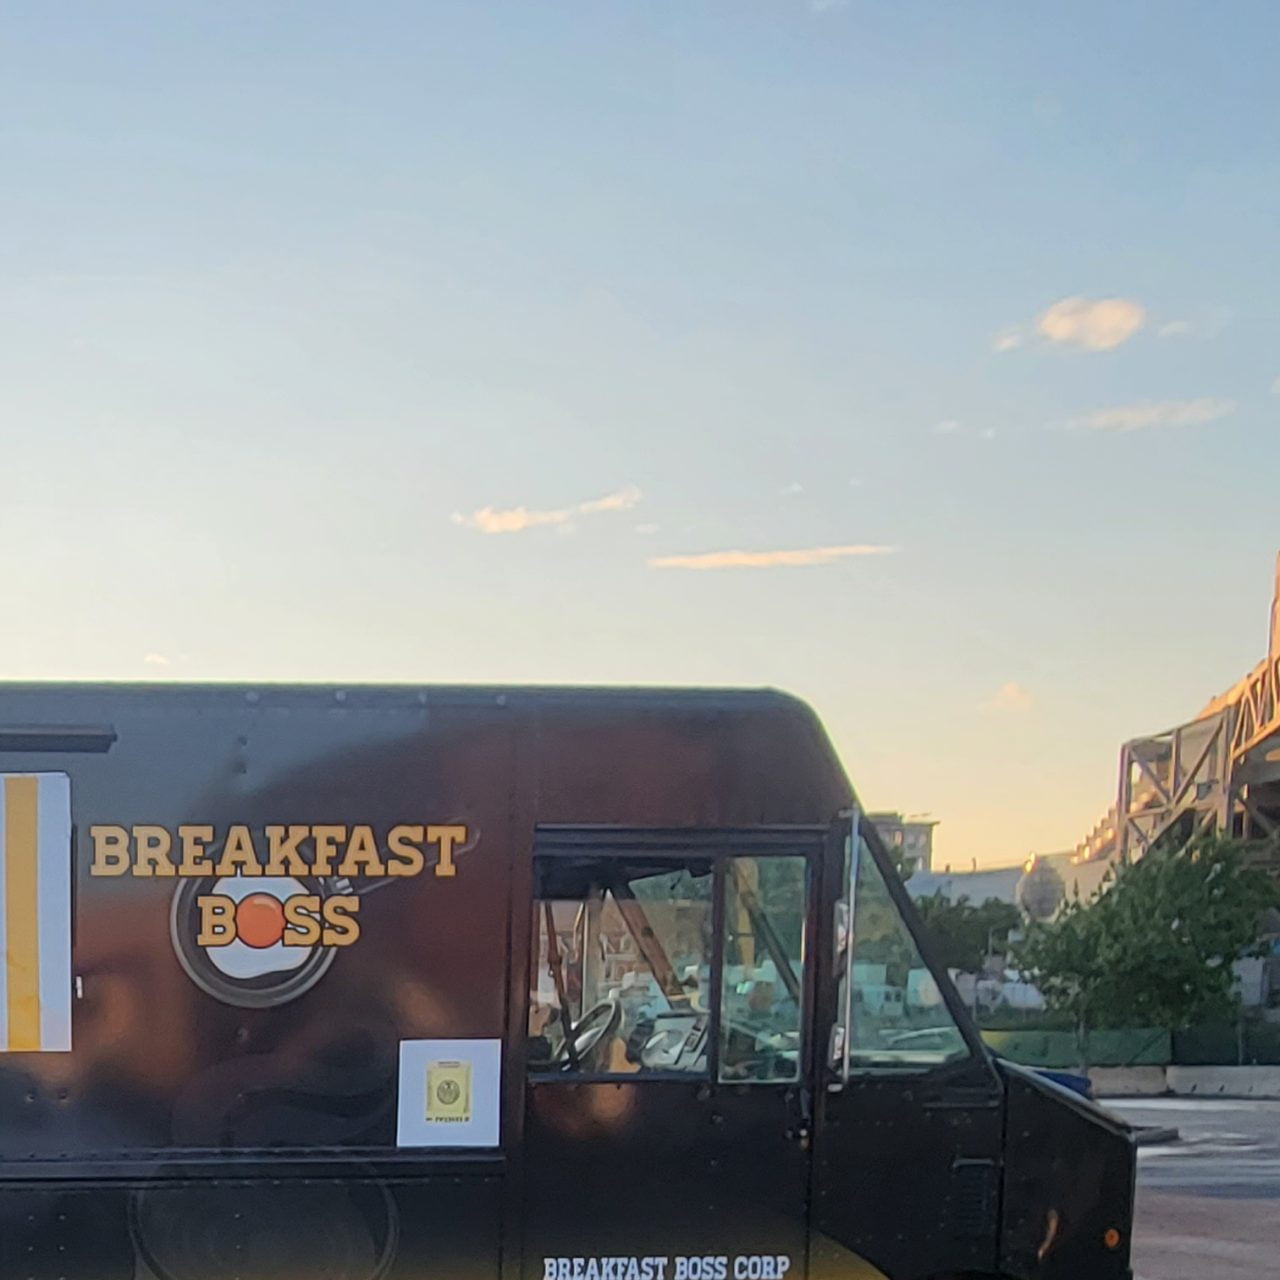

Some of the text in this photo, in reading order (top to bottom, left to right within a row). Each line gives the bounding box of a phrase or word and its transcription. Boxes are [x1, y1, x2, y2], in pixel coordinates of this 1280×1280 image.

[88, 824, 468, 878] BREAKFAST
[196, 892, 361, 949] BOSS
[674, 1256, 729, 1280] BOSS
[733, 1255, 791, 1280] CORP
